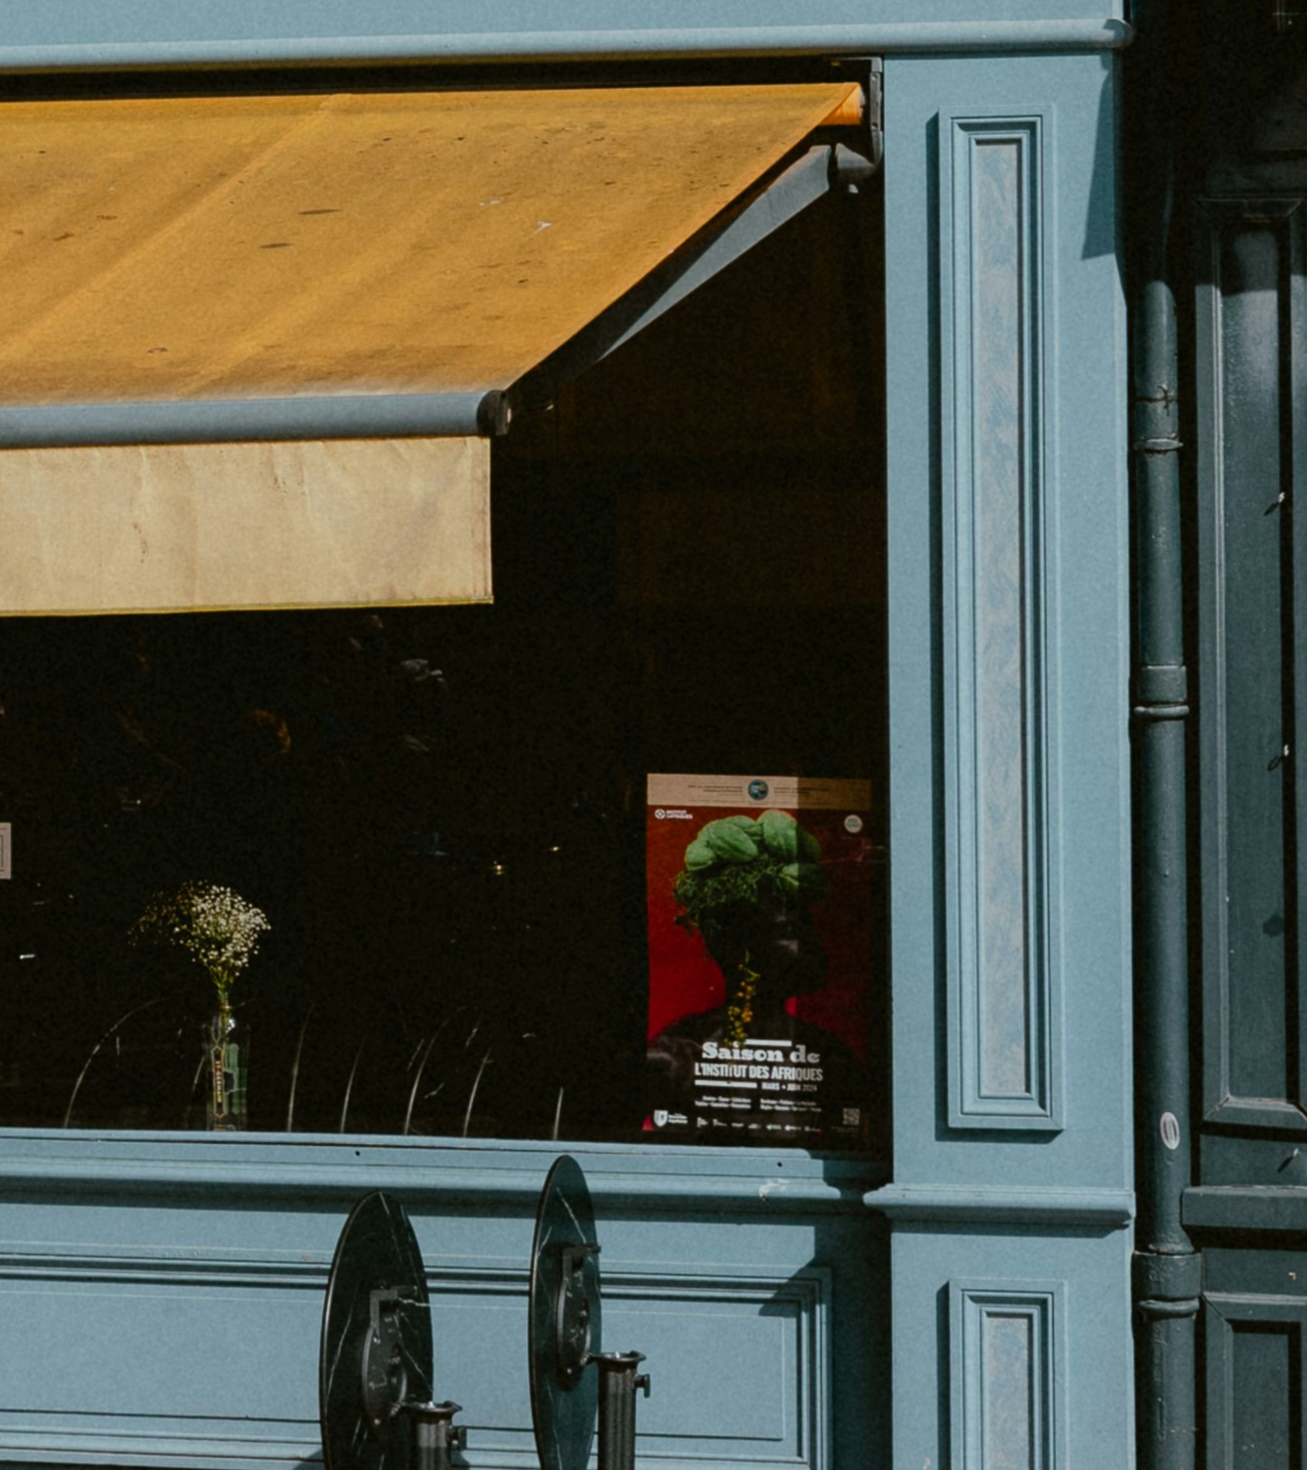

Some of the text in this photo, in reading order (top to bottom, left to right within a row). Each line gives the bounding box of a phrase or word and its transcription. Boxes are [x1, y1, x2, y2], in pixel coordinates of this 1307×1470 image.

[701, 1041, 821, 1064] Saison de
[694, 1062, 824, 1082] L'INSTITUT DES AFRIQUES
